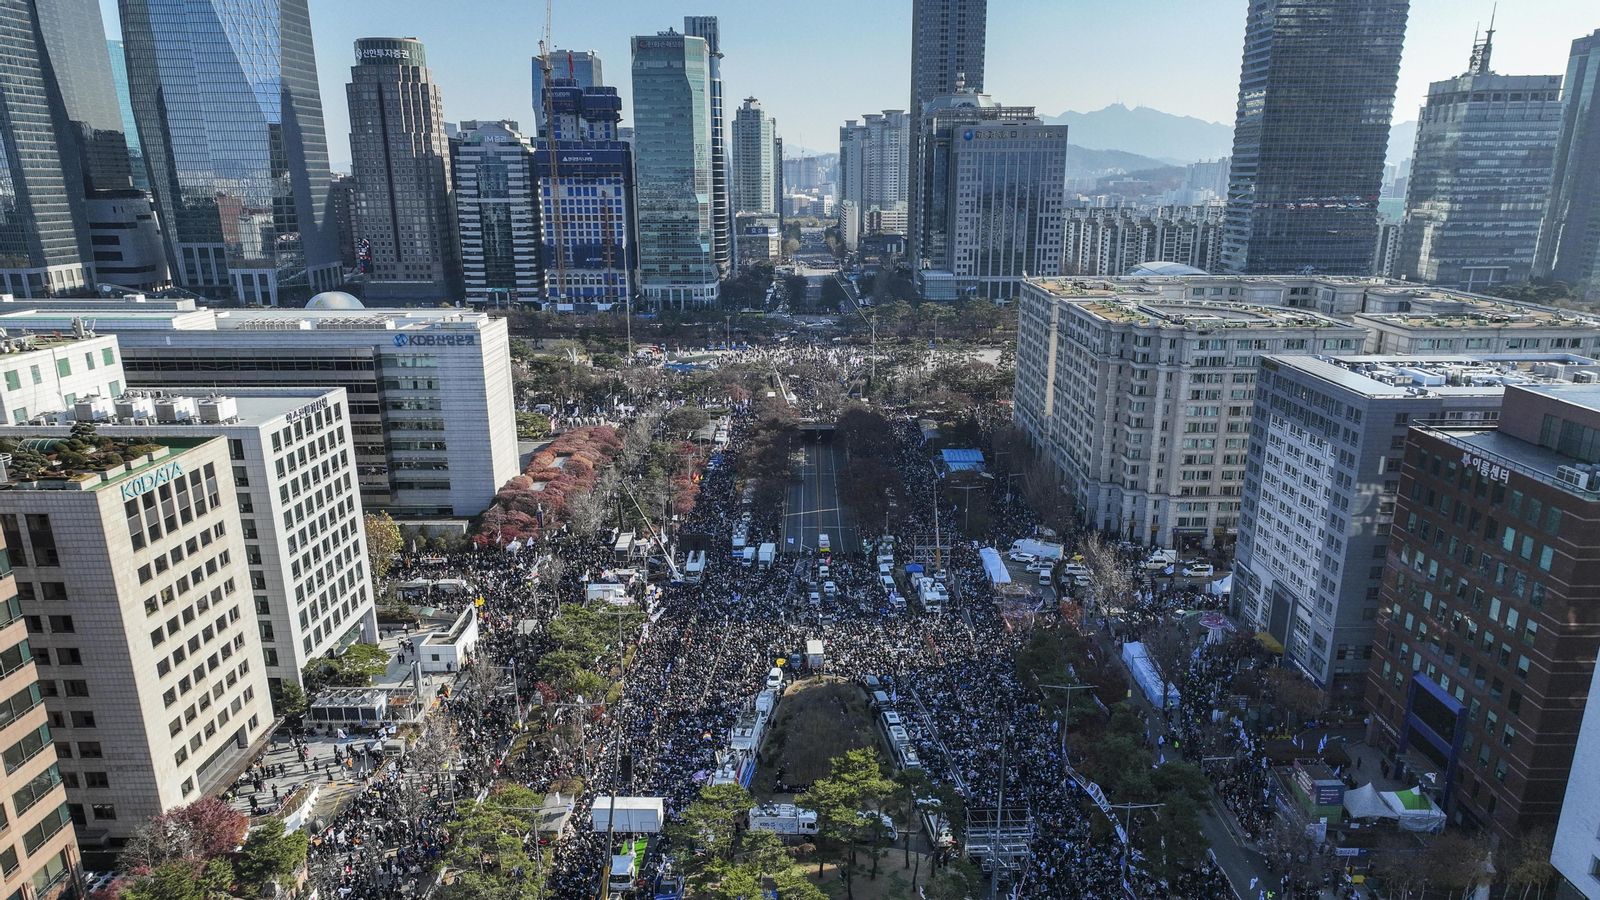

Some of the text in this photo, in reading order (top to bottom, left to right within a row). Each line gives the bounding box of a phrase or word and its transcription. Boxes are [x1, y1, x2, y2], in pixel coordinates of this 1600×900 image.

[363, 48, 410, 59] 신한투자증권
[409, 334, 475, 346] KDB산업은행
[1472, 457, 1510, 484] 이룸센터
[120, 461, 183, 502] KODATA
